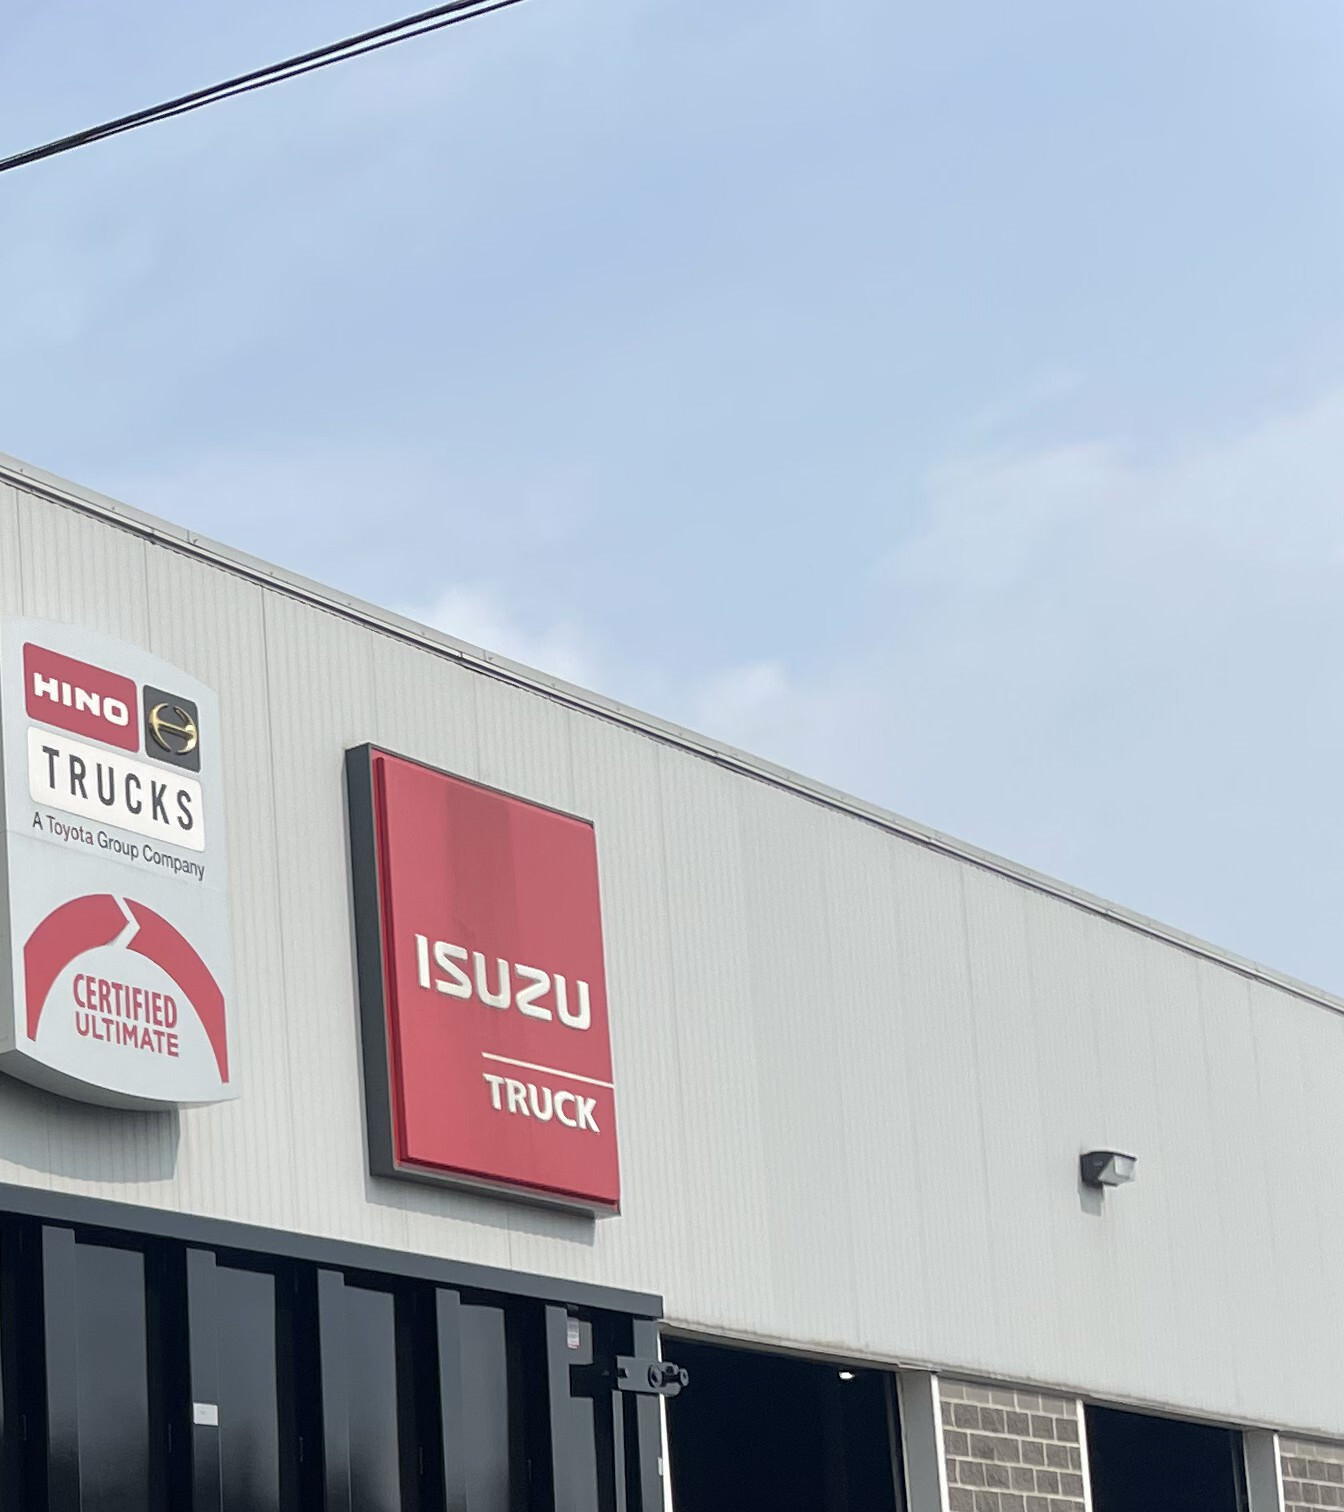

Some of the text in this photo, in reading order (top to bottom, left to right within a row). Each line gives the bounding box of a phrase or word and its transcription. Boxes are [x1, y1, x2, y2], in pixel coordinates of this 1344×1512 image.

[33, 672, 129, 726] HINO
[42, 745, 193, 831] TRUCKS
[32, 811, 205, 881] A Toyota Group Company
[73, 973, 178, 1029] CERTIFIED
[415, 933, 591, 1030] ISUZU
[75, 1011, 179, 1058] ULTIMATE
[482, 1073, 600, 1133] TRUCK
